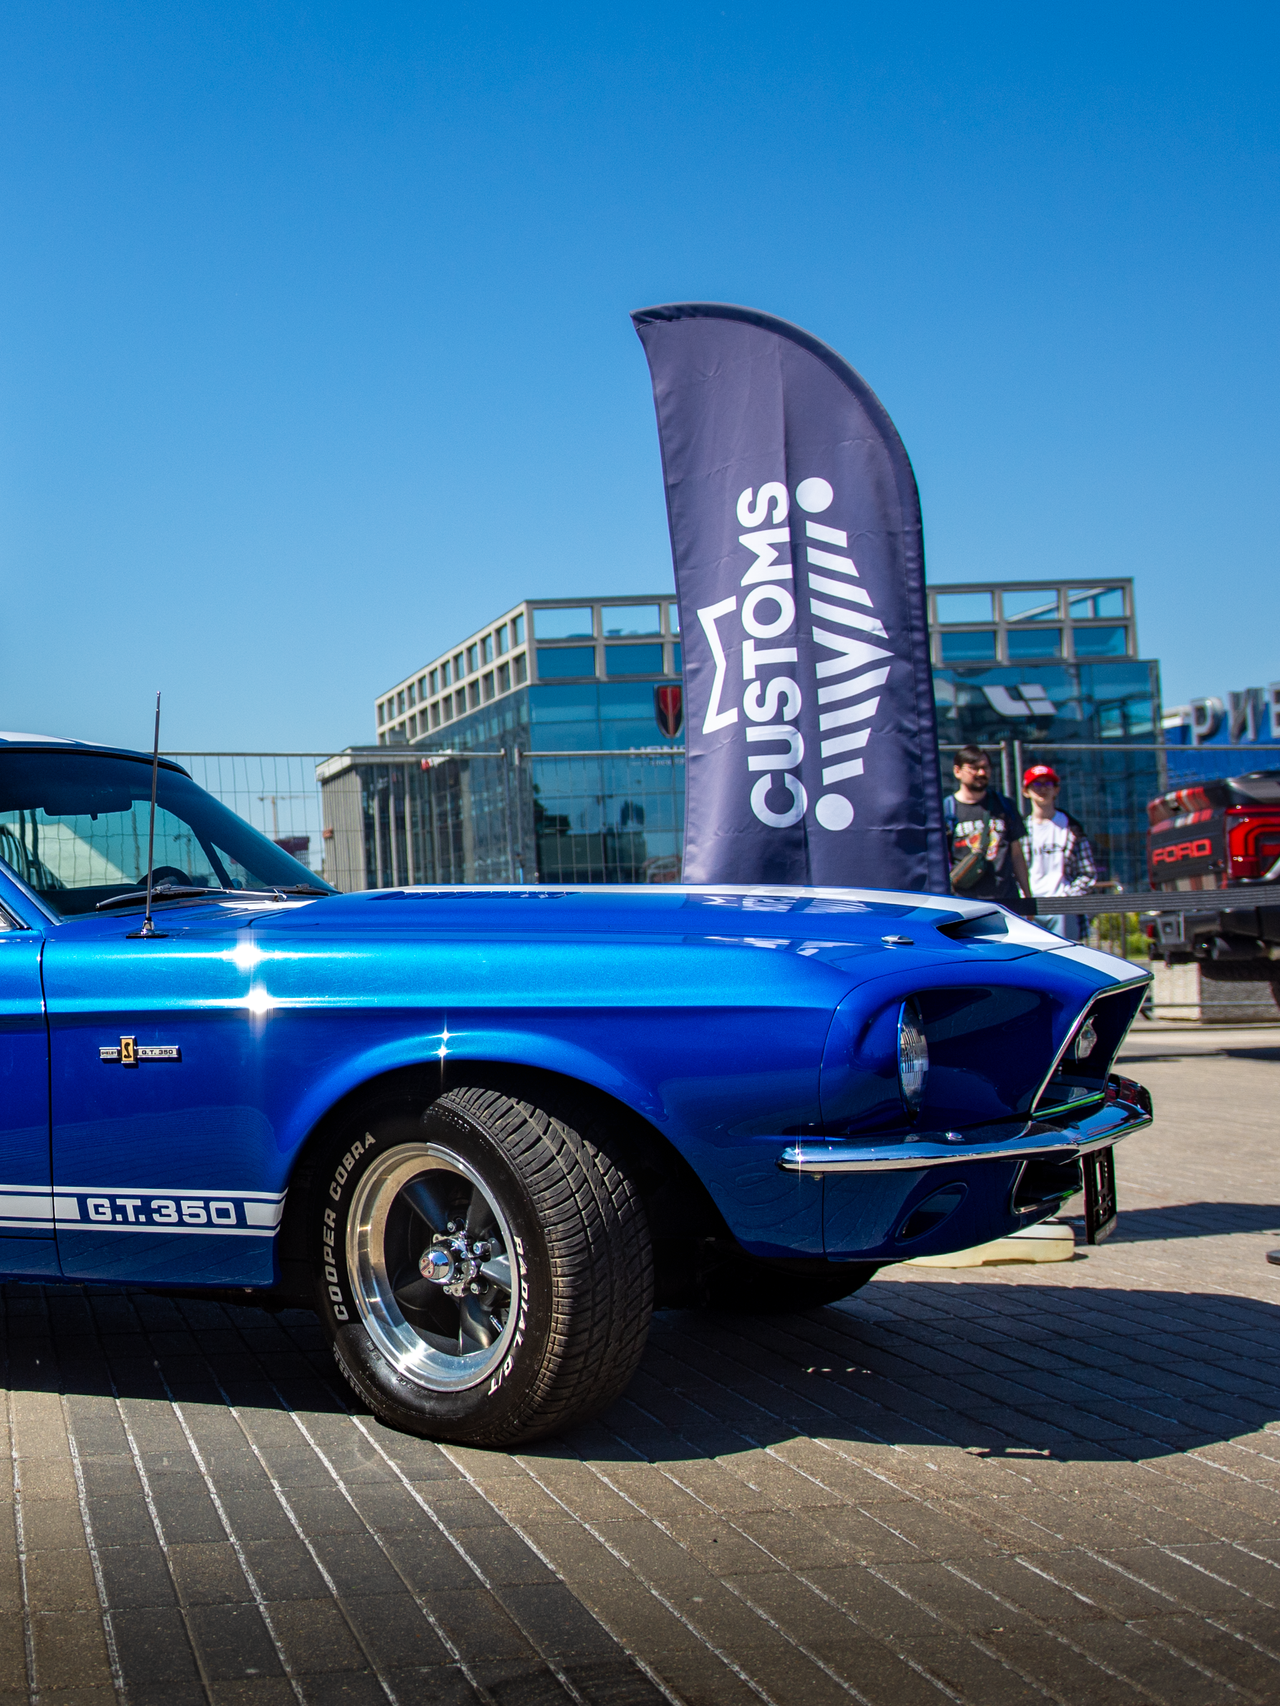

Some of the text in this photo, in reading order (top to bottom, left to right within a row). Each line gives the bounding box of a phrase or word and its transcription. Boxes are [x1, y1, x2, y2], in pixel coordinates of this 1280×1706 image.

[736, 481, 809, 829] CUSTOMS
[1152, 838, 1212, 867] FORD
[323, 1131, 377, 1321] COOPER COBRA
[487, 1235, 530, 1397] RADIAL G/T
